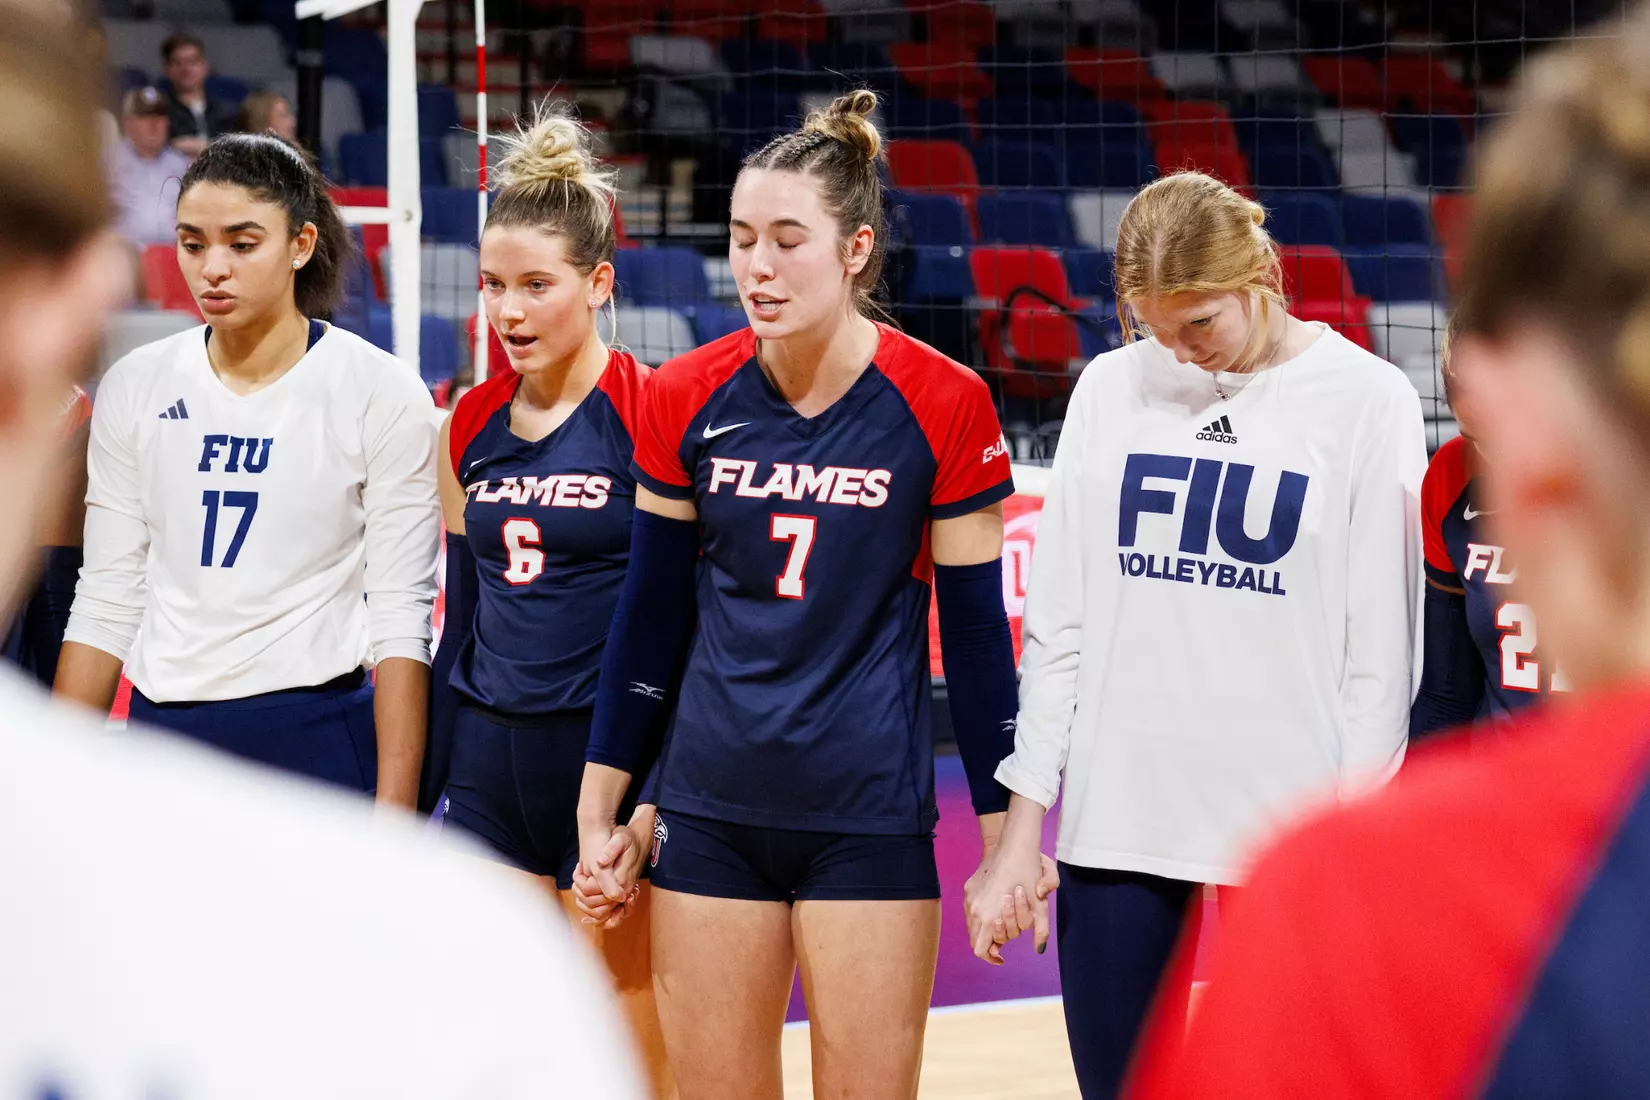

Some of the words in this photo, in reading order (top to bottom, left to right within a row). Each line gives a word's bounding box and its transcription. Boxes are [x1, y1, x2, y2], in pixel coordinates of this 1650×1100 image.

[198, 434, 273, 474] FIU
[1196, 431, 1238, 445] adidas
[708, 457, 892, 508] FLAMES
[1118, 453, 1309, 564] FIU
[200, 491, 259, 568] 17
[501, 517, 546, 586] 6
[769, 514, 816, 600] 7
[1119, 553, 1286, 596] VOLLEYBALL
[1463, 543, 1517, 584] FL
[1495, 600, 1574, 692] 2
